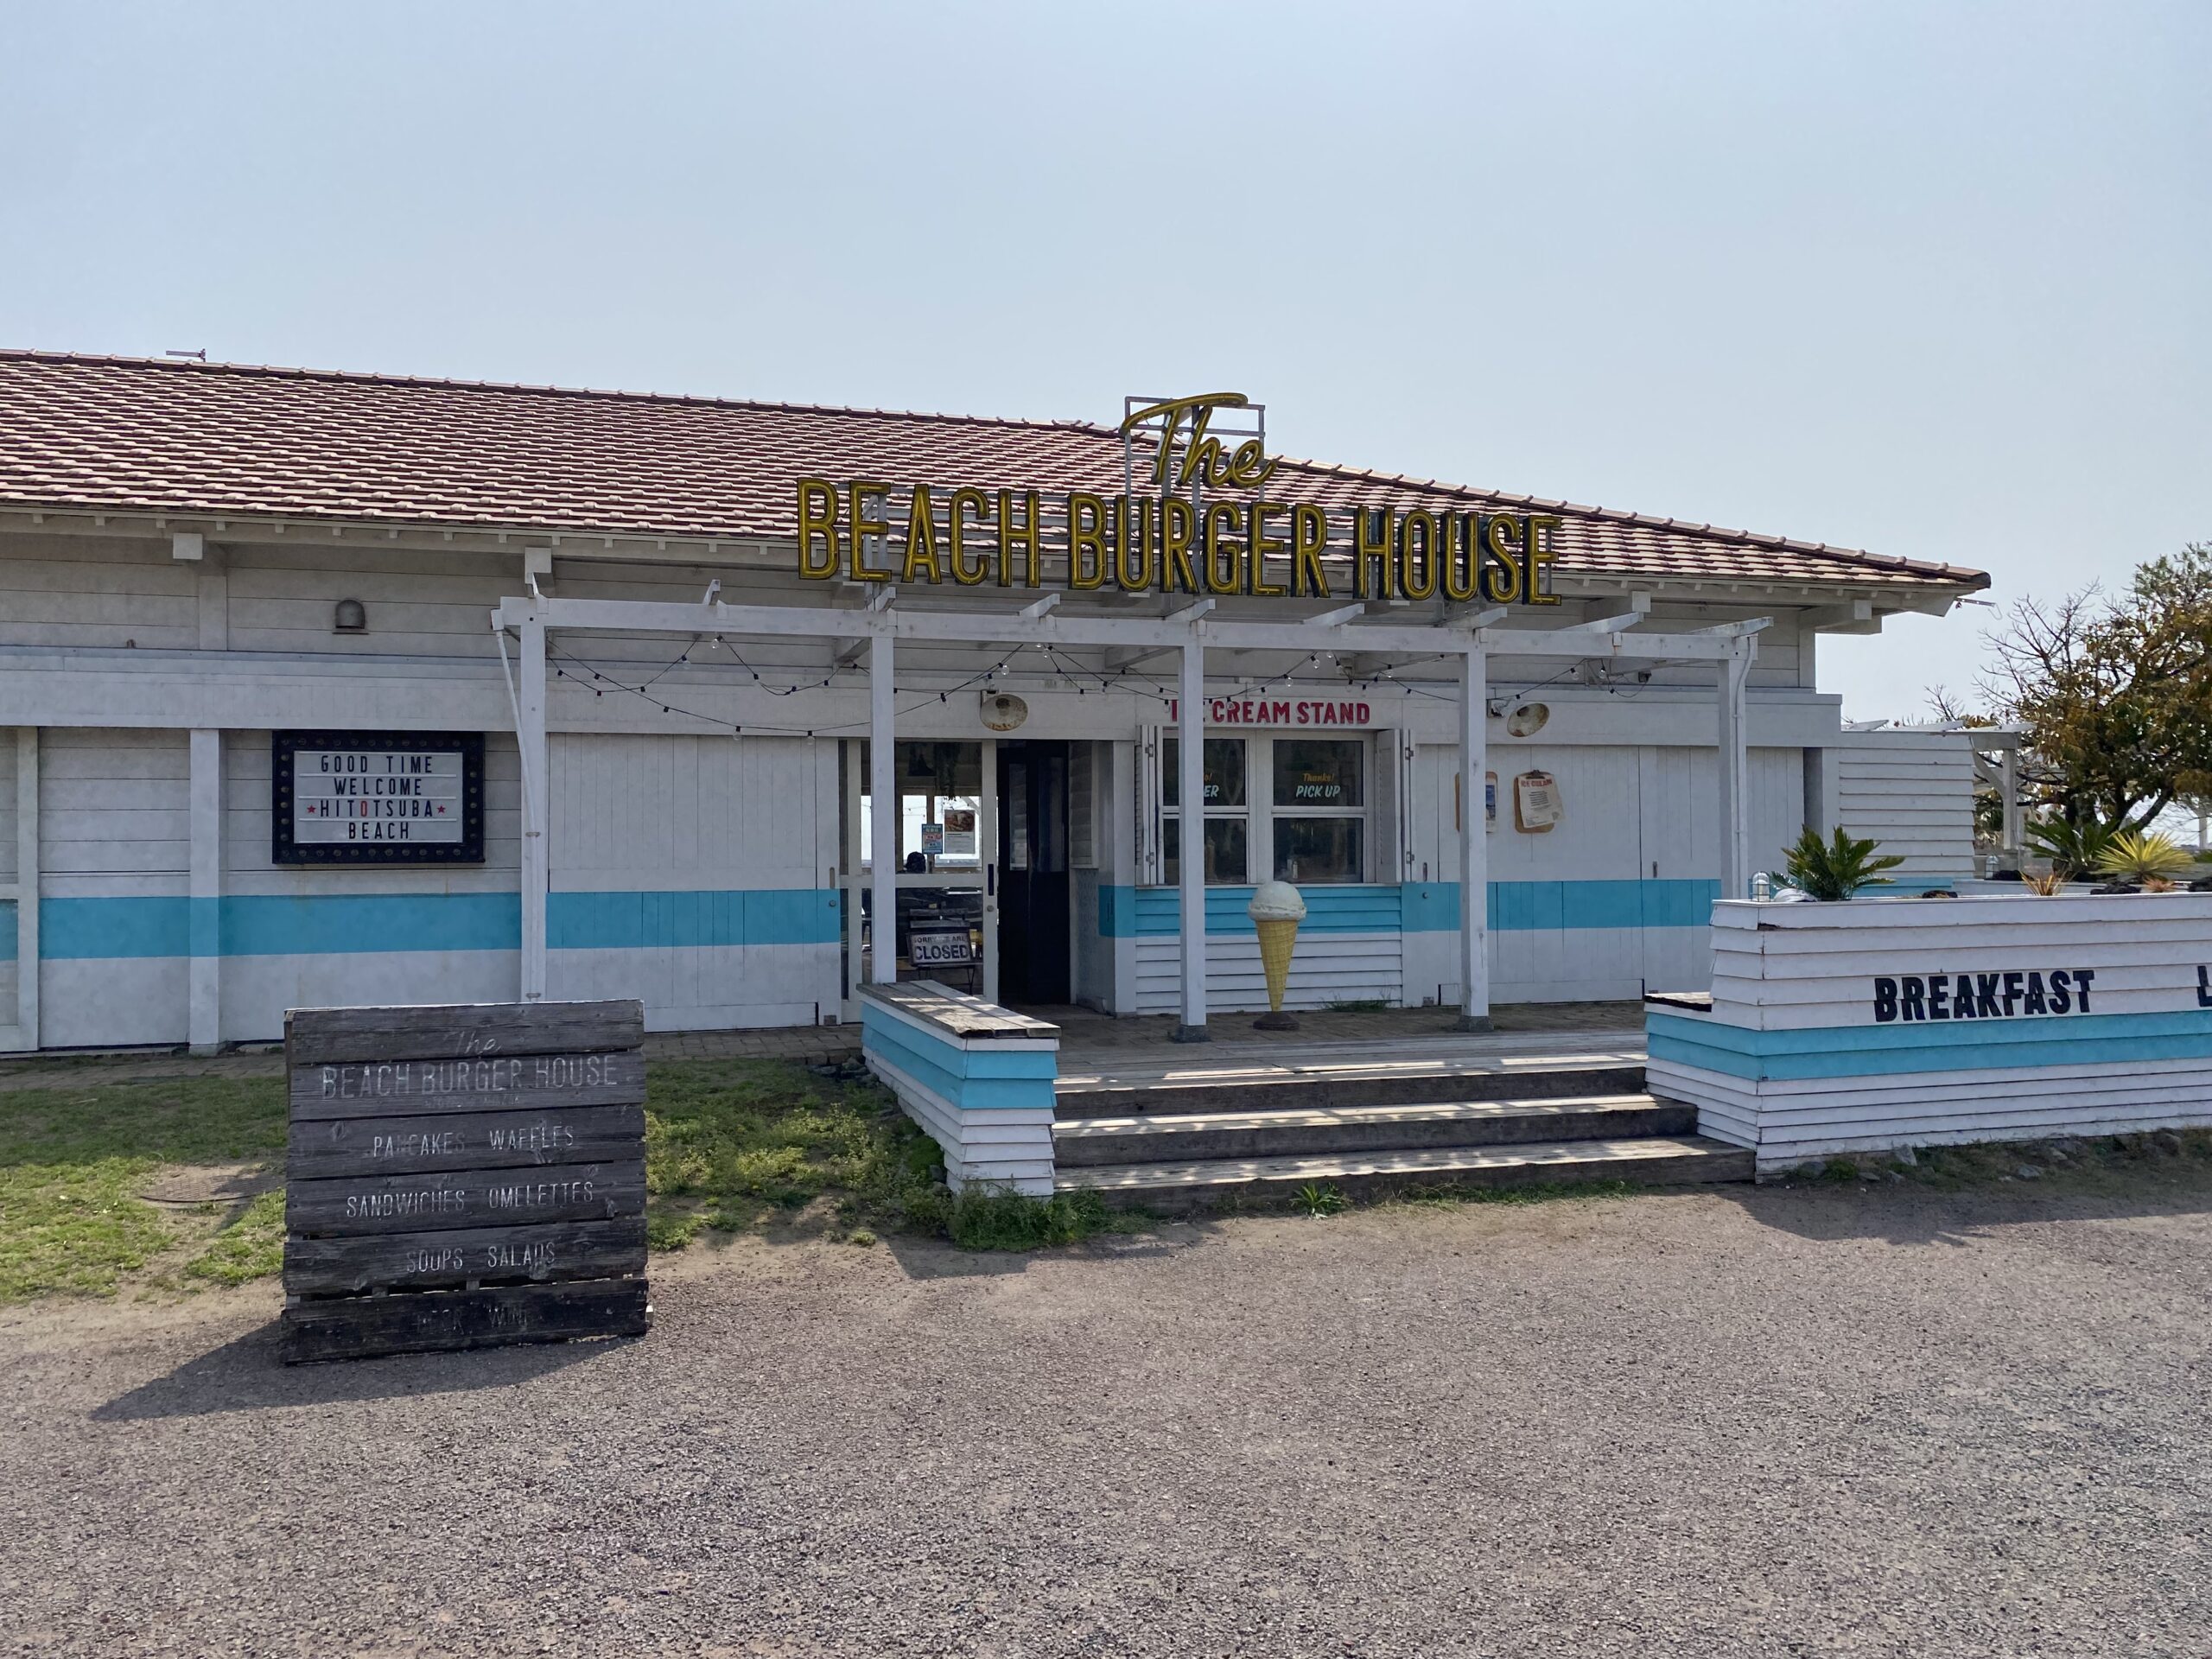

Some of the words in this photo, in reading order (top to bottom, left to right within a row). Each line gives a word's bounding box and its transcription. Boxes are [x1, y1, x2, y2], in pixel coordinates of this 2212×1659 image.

[1121, 392, 1280, 487] The
[797, 476, 1039, 588] BEACH
[1067, 492, 1332, 599] BURGER
[1351, 505, 1562, 607] HOUSE
[1212, 700, 1290, 723] CREAM
[1297, 702, 1370, 725] STAND
[321, 755, 367, 772] GOOD
[386, 755, 432, 773] TIME
[334, 778, 422, 795] WELCOME
[1296, 785, 1322, 798] PICK
[1325, 785, 1341, 798] UP
[320, 799, 433, 817] HITOTSUBA
[348, 822, 409, 839] BEACH
[915, 944, 968, 960] CLOSED
[1873, 969, 2095, 1022] BREAKFAST
[442, 1029, 503, 1054] The
[322, 1064, 410, 1100] BEACH
[422, 1059, 523, 1096] BURGER
[535, 1055, 618, 1088] HOUSE
[489, 1125, 574, 1151] WAFFLES
[346, 1190, 466, 1218] SANDWICHES
[406, 1248, 463, 1273] SOUPS
[487, 1242, 555, 1268] SALADS
